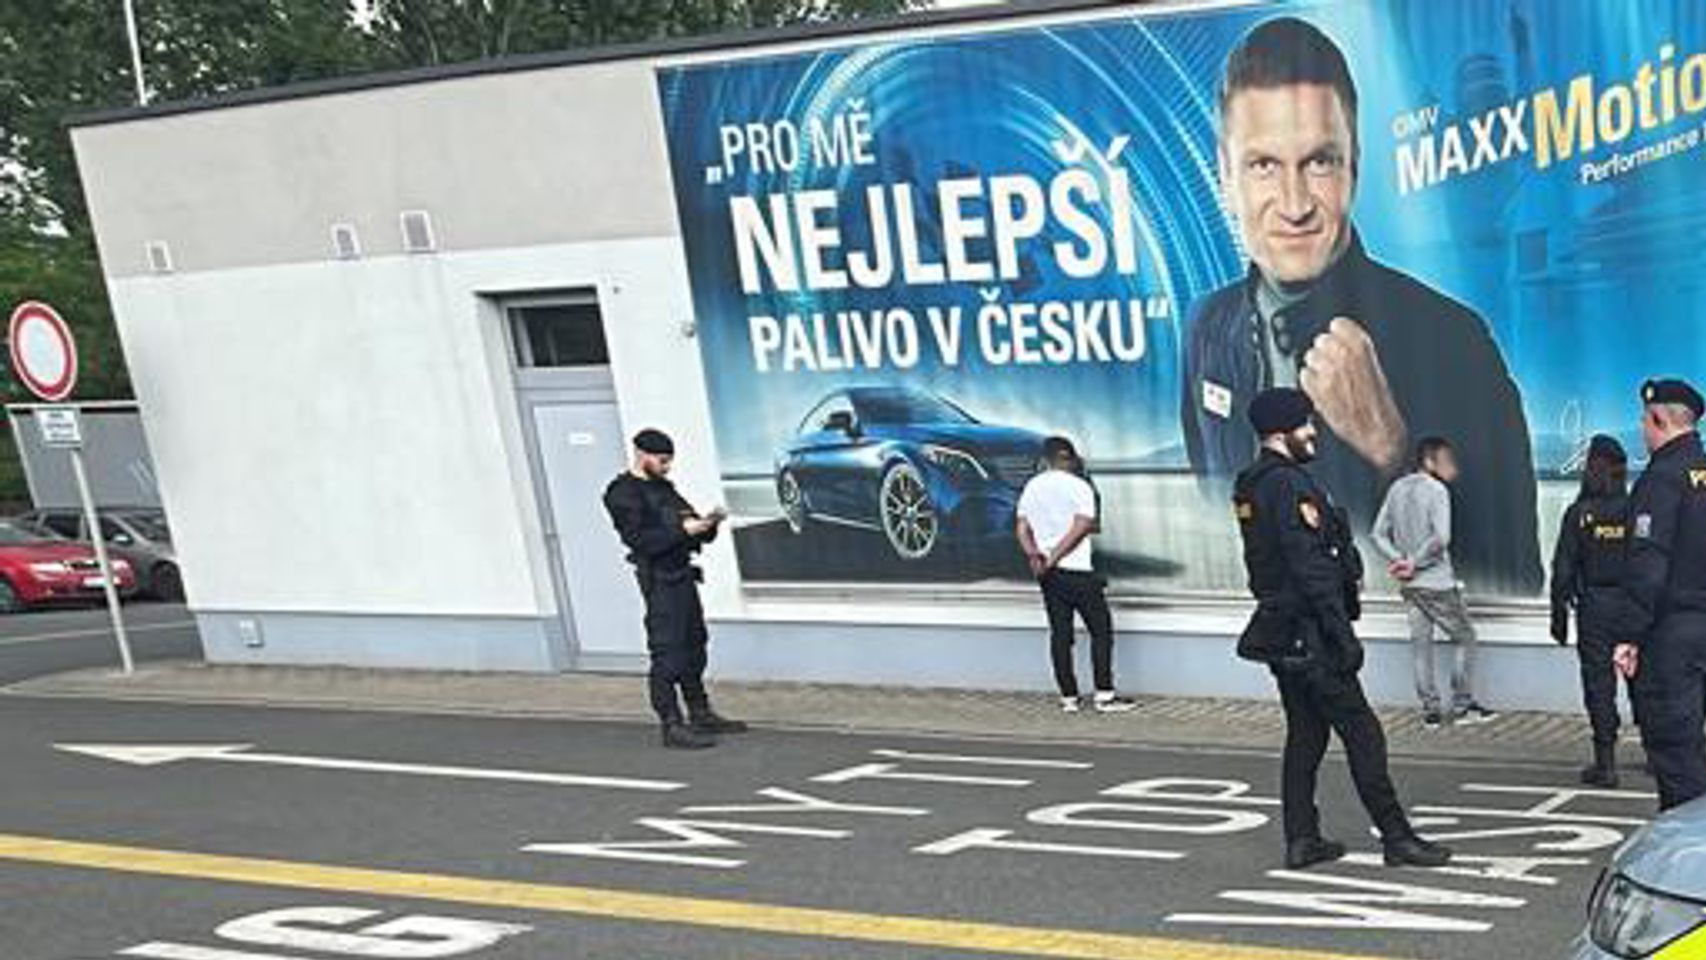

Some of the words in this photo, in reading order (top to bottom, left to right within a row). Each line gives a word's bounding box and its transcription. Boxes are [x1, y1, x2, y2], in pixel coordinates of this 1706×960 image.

[810, 97, 875, 171] MĚ
[1578, 130, 1700, 186] Performance
[729, 134, 1139, 295] NEJLEPŠÍ
[749, 307, 919, 374] PALIVO
[927, 306, 961, 367] V
[910, 776, 1283, 859] TOP
